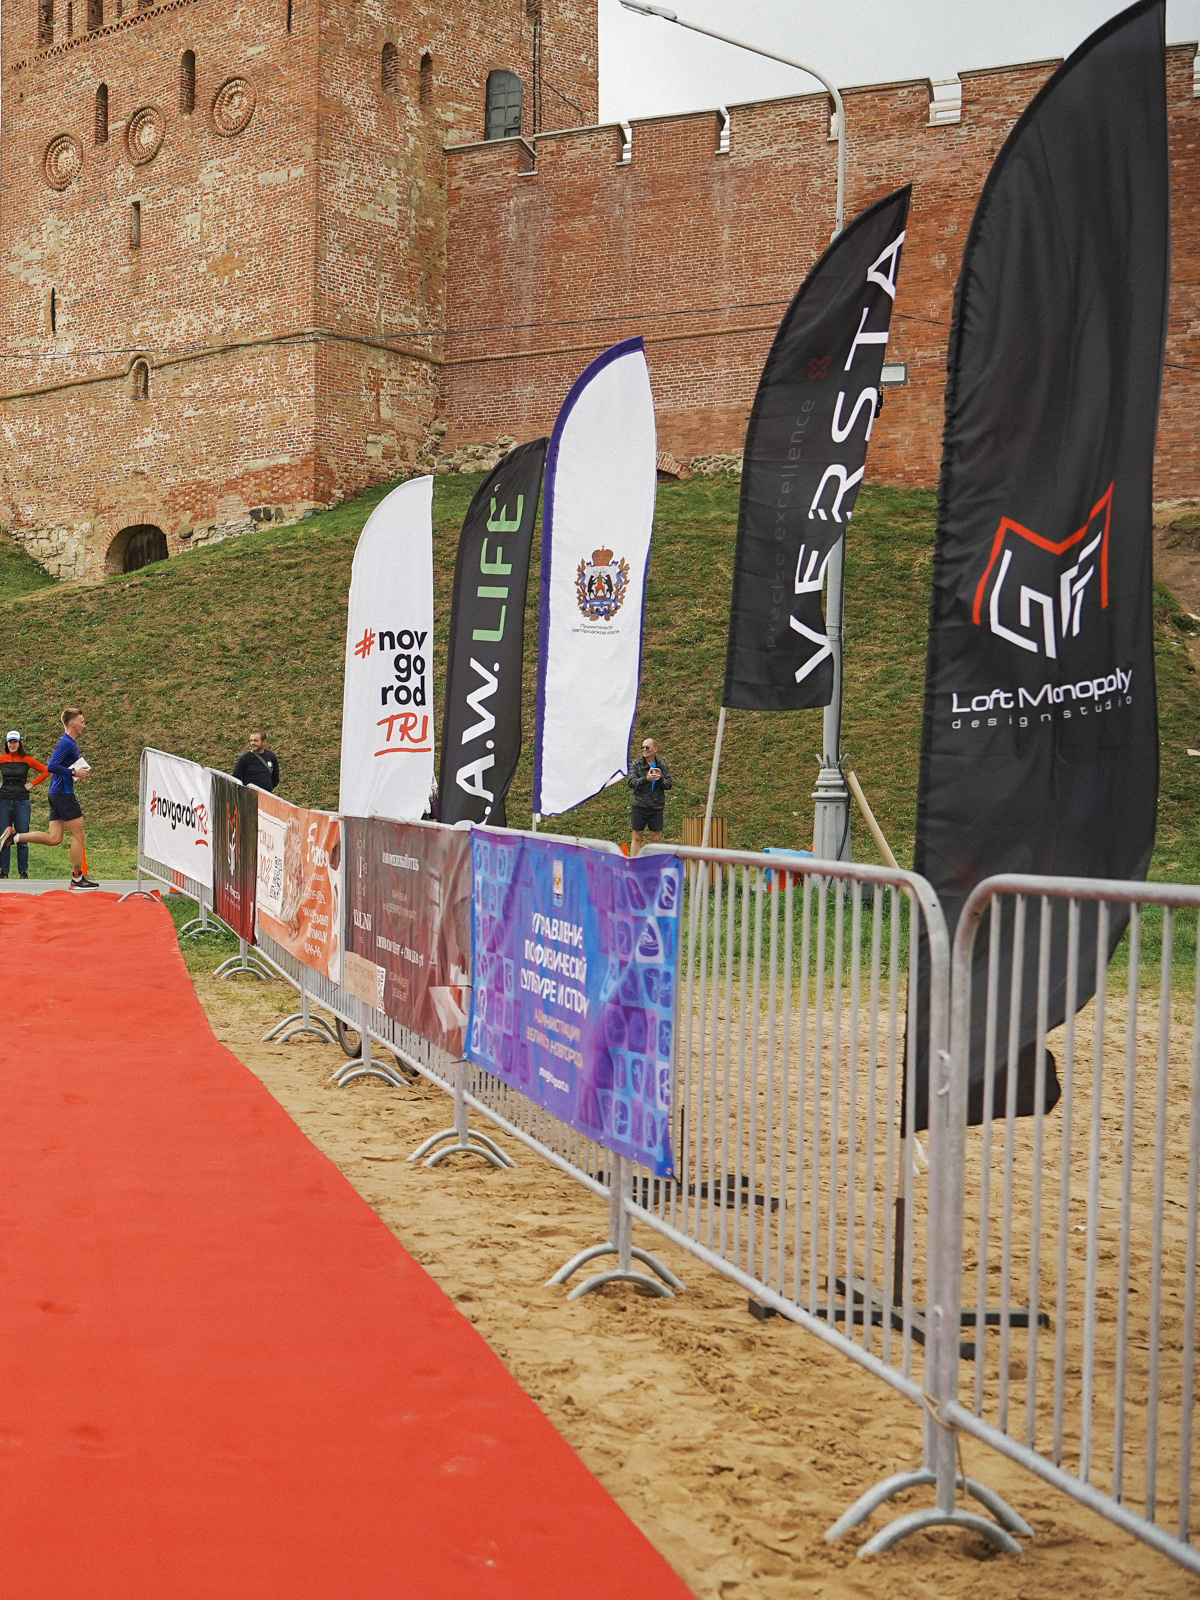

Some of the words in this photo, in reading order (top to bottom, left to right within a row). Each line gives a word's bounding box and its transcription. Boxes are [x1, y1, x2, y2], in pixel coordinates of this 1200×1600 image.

[789, 230, 907, 685] VERSTA
[472, 494, 524, 642] LIFE
[355, 627, 428, 660] #nov
[394, 654, 425, 683] go
[381, 676, 427, 707] rod
[952, 688, 1015, 713] Loft
[1017, 667, 1133, 708] Monopoly
[376, 712, 429, 744] TRI
[454, 657, 501, 826] .A.W.
